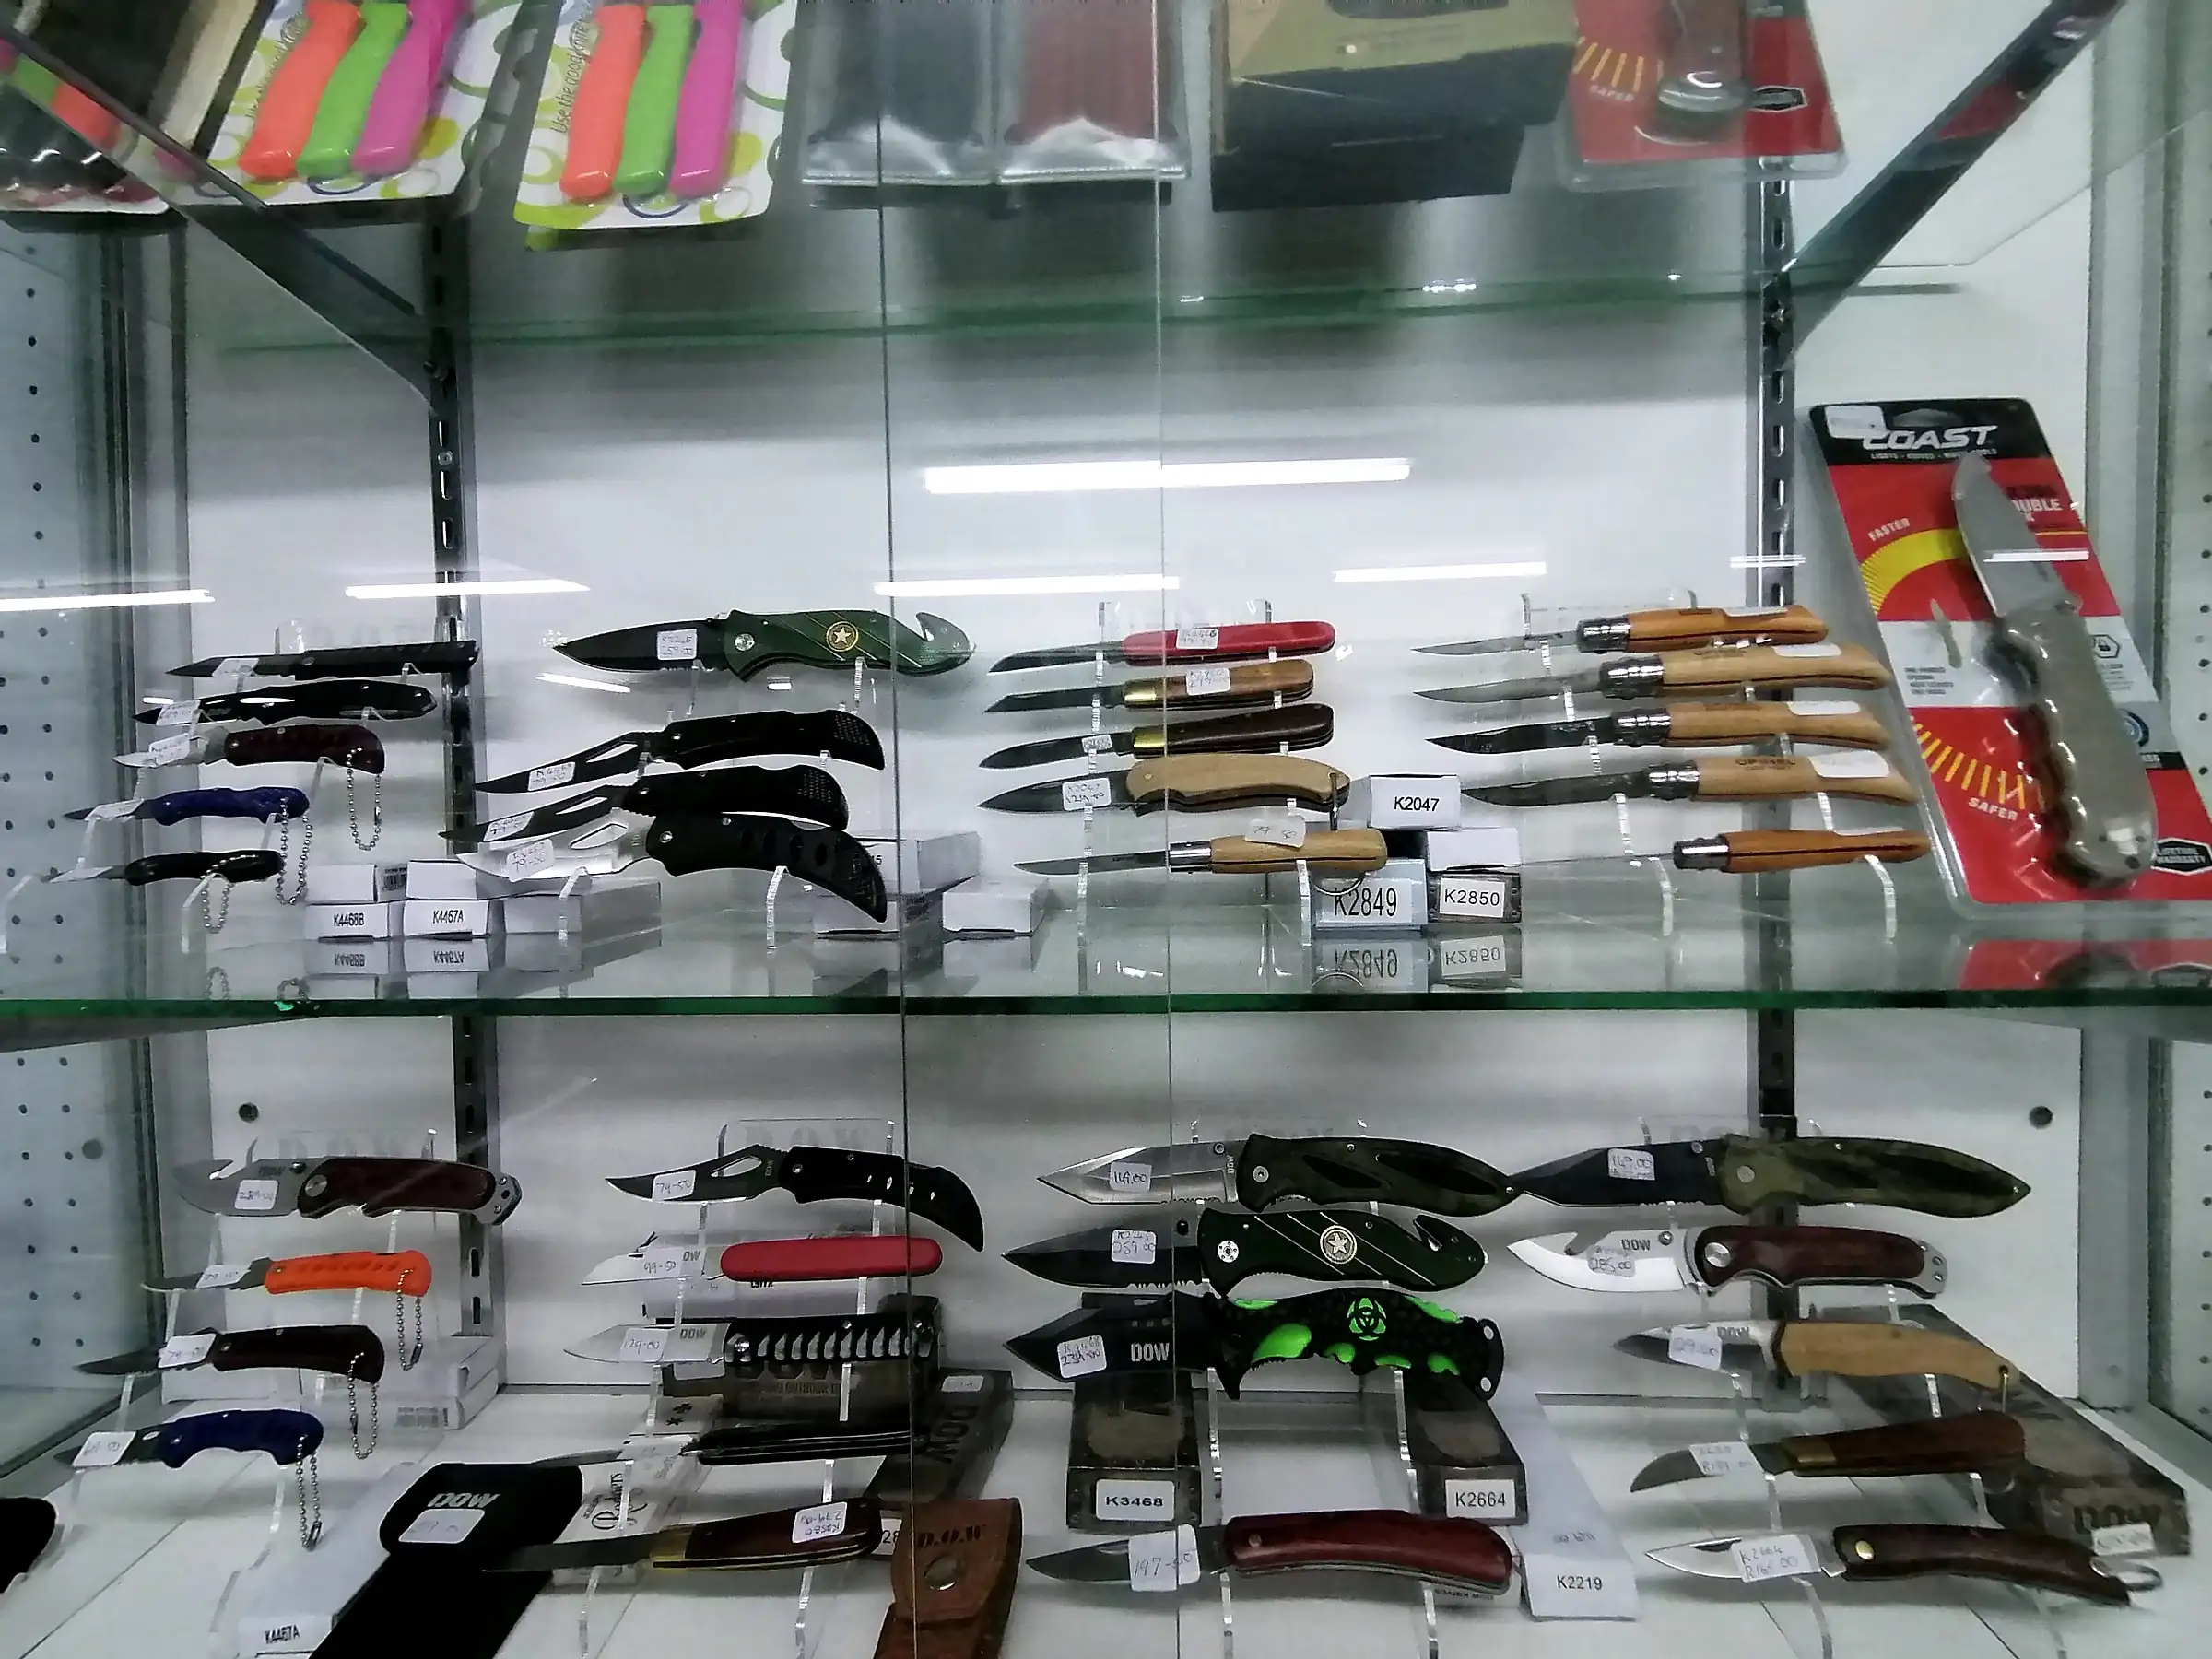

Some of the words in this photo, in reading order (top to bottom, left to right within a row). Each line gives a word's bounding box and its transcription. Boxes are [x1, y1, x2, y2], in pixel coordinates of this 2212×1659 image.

[1862, 424, 1998, 451] COAST
[1867, 518, 1911, 542] FASTER
[1394, 796, 1440, 812] K2047
[1969, 796, 2018, 821] SAFER
[1335, 887, 1398, 917] K2849
[1444, 889, 1500, 907] K2850
[433, 909, 464, 924] K4467A
[1620, 1238, 1651, 1251] DOW
[1130, 1343, 1170, 1362] DOW
[427, 1492, 501, 1508] DOW
[1106, 1496, 1163, 1507] K3468
[1455, 1491, 1506, 1507] K2664
[1557, 1574, 1603, 1591] K2219
